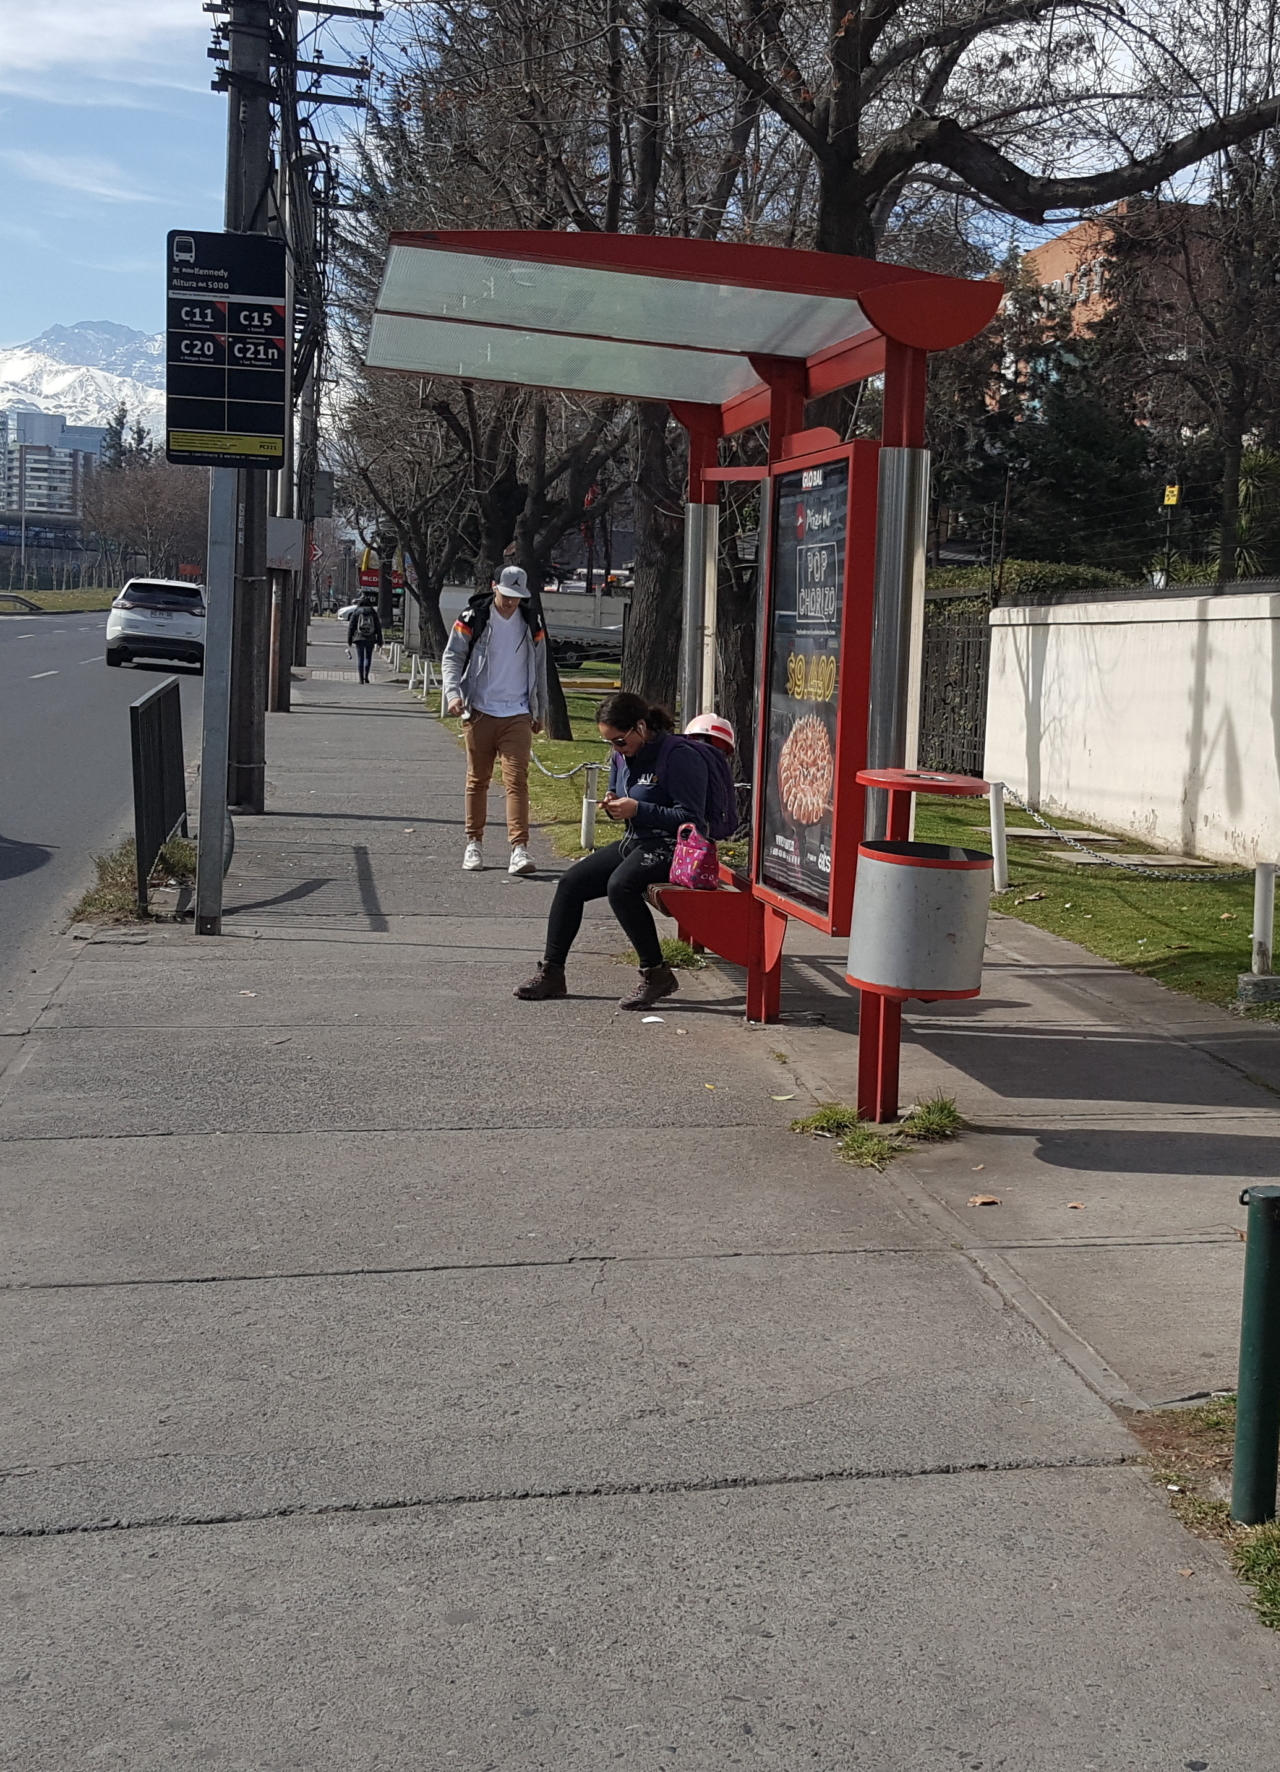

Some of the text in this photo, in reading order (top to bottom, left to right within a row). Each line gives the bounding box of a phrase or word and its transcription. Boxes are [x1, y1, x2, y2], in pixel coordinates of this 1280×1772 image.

[194, 267, 229, 279] Kennedy
[172, 278, 197, 288] Altura
[207, 281, 229, 290] 5000
[181, 306, 215, 323] C11
[239, 310, 273, 327] C15
[180, 340, 214, 356] C20
[233, 343, 278, 360] C21n
[807, 550, 828, 582] POP
[799, 586, 835, 615] CHORIZO
[786, 651, 837, 702] $9.490
